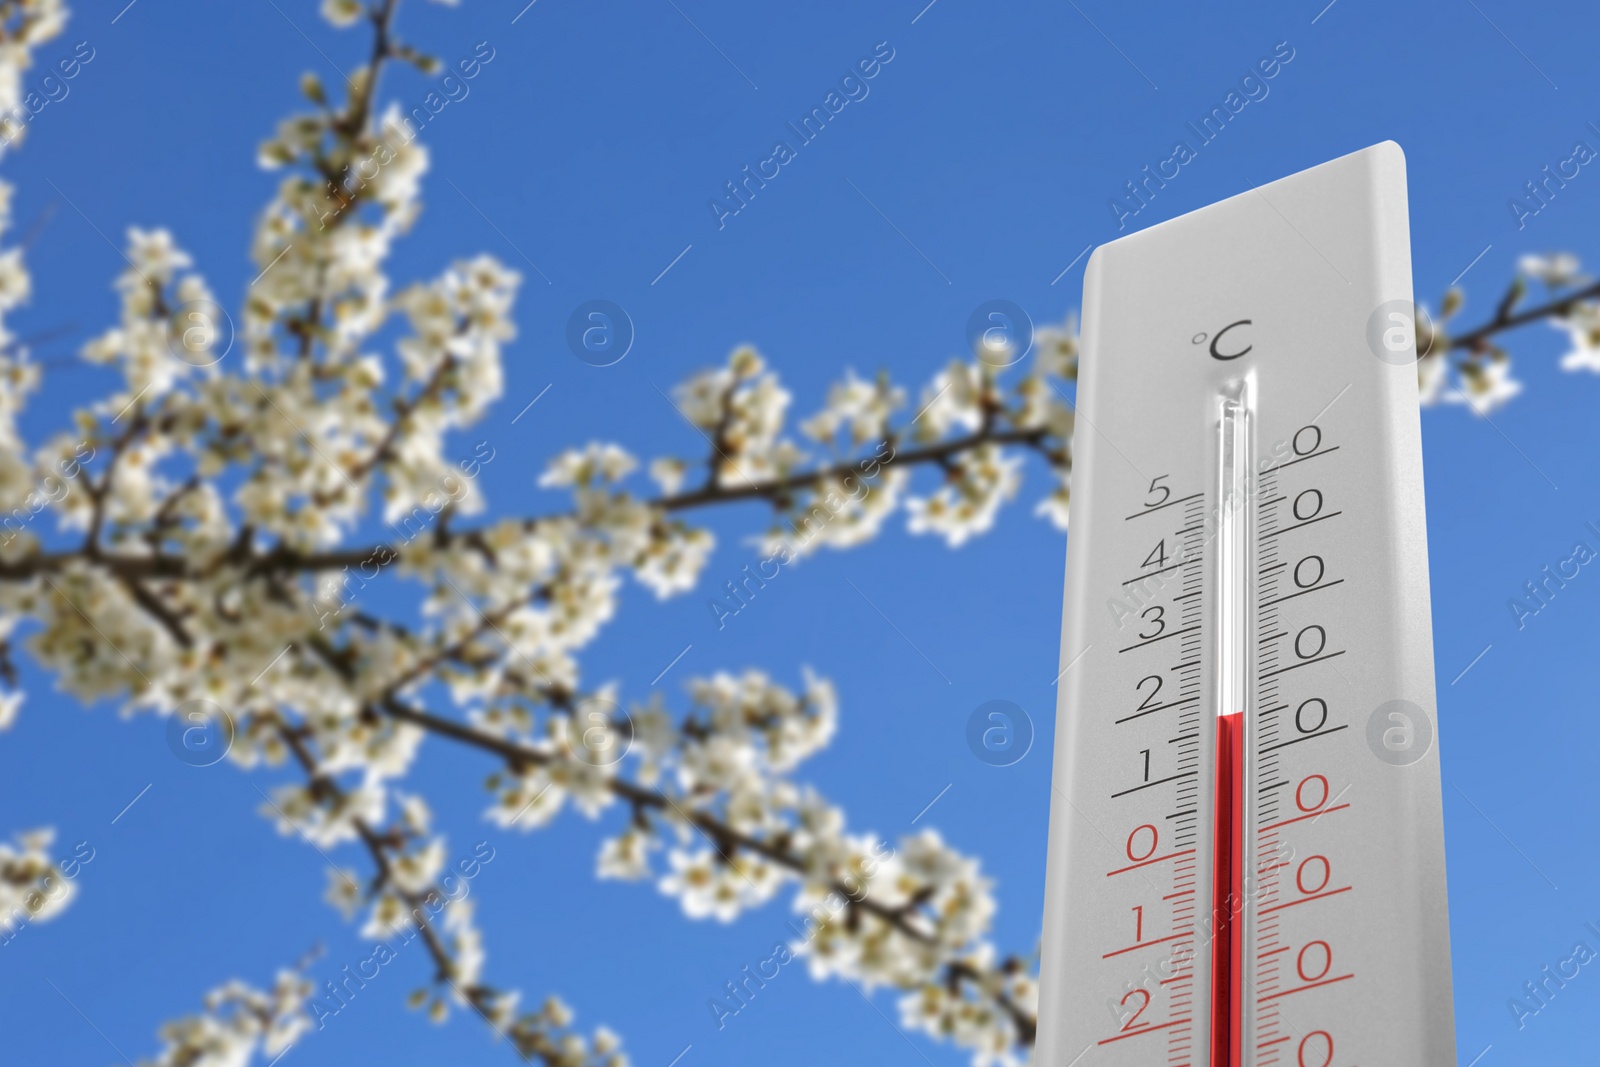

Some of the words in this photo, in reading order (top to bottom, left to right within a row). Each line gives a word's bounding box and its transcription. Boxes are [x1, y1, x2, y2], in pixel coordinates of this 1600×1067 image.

[1191, 319, 1253, 361] °C
[1144, 474, 1171, 508] 5
[1292, 424, 1322, 456] 0
[1139, 537, 1170, 569] 4
[1292, 488, 1324, 521] 0
[1138, 605, 1166, 640] 3
[1293, 554, 1325, 589] 0
[1135, 674, 1164, 712] 2
[1294, 624, 1327, 660] 0
[1139, 748, 1151, 783] 1
[1294, 697, 1328, 734] 0
[1126, 823, 1159, 863] 0
[1295, 773, 1330, 813] 0
[1131, 905, 1143, 943] 1
[1295, 854, 1331, 896] 0
[1119, 988, 1151, 1033] 2
[1296, 939, 1333, 983] 0
